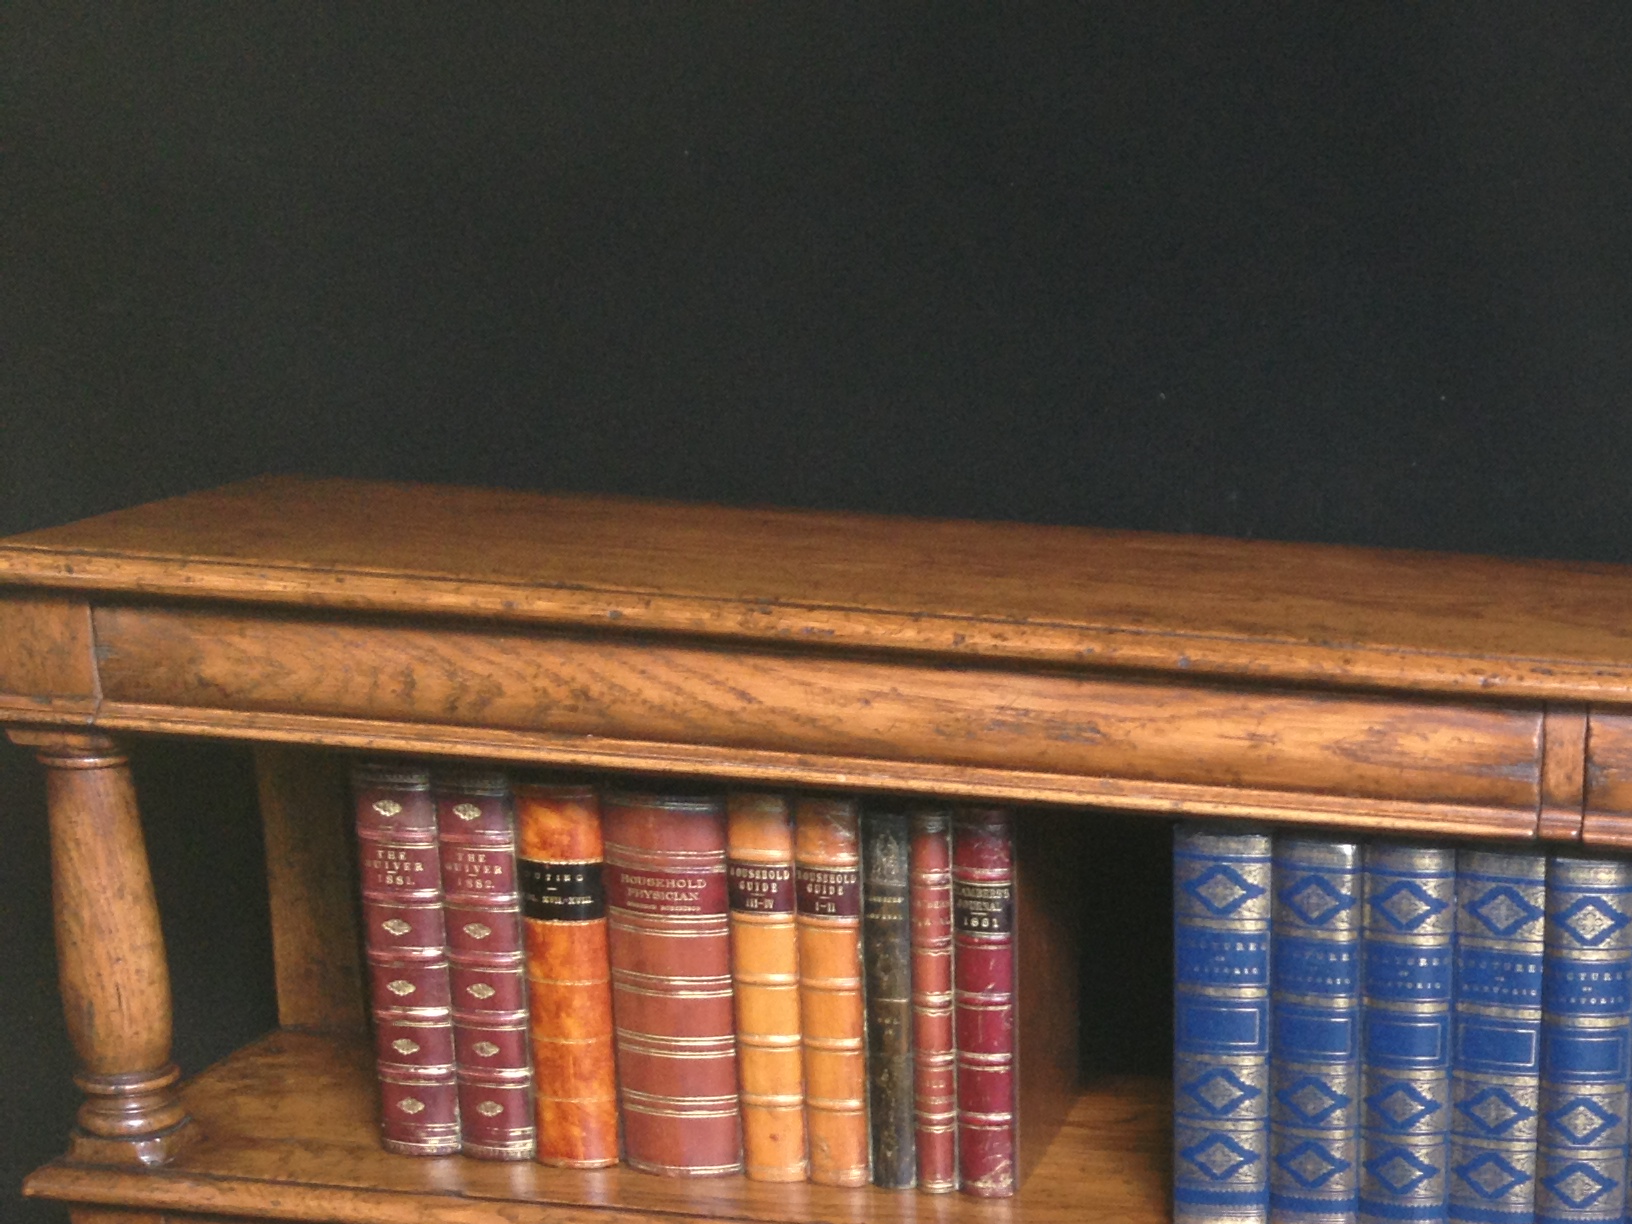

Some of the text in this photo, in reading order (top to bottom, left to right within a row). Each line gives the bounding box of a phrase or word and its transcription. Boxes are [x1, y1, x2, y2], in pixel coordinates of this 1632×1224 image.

[377, 850, 406, 861] THE
[457, 853, 486, 863] THE
[728, 867, 790, 880] HOUSEHOLD
[797, 869, 857, 884] HOUSEHOLD
[620, 873, 707, 889] HOUSEHOLD
[738, 880, 779, 893] GUIDE
[627, 887, 699, 901] PHYSICIAN
[806, 883, 844, 897] GUIDE
